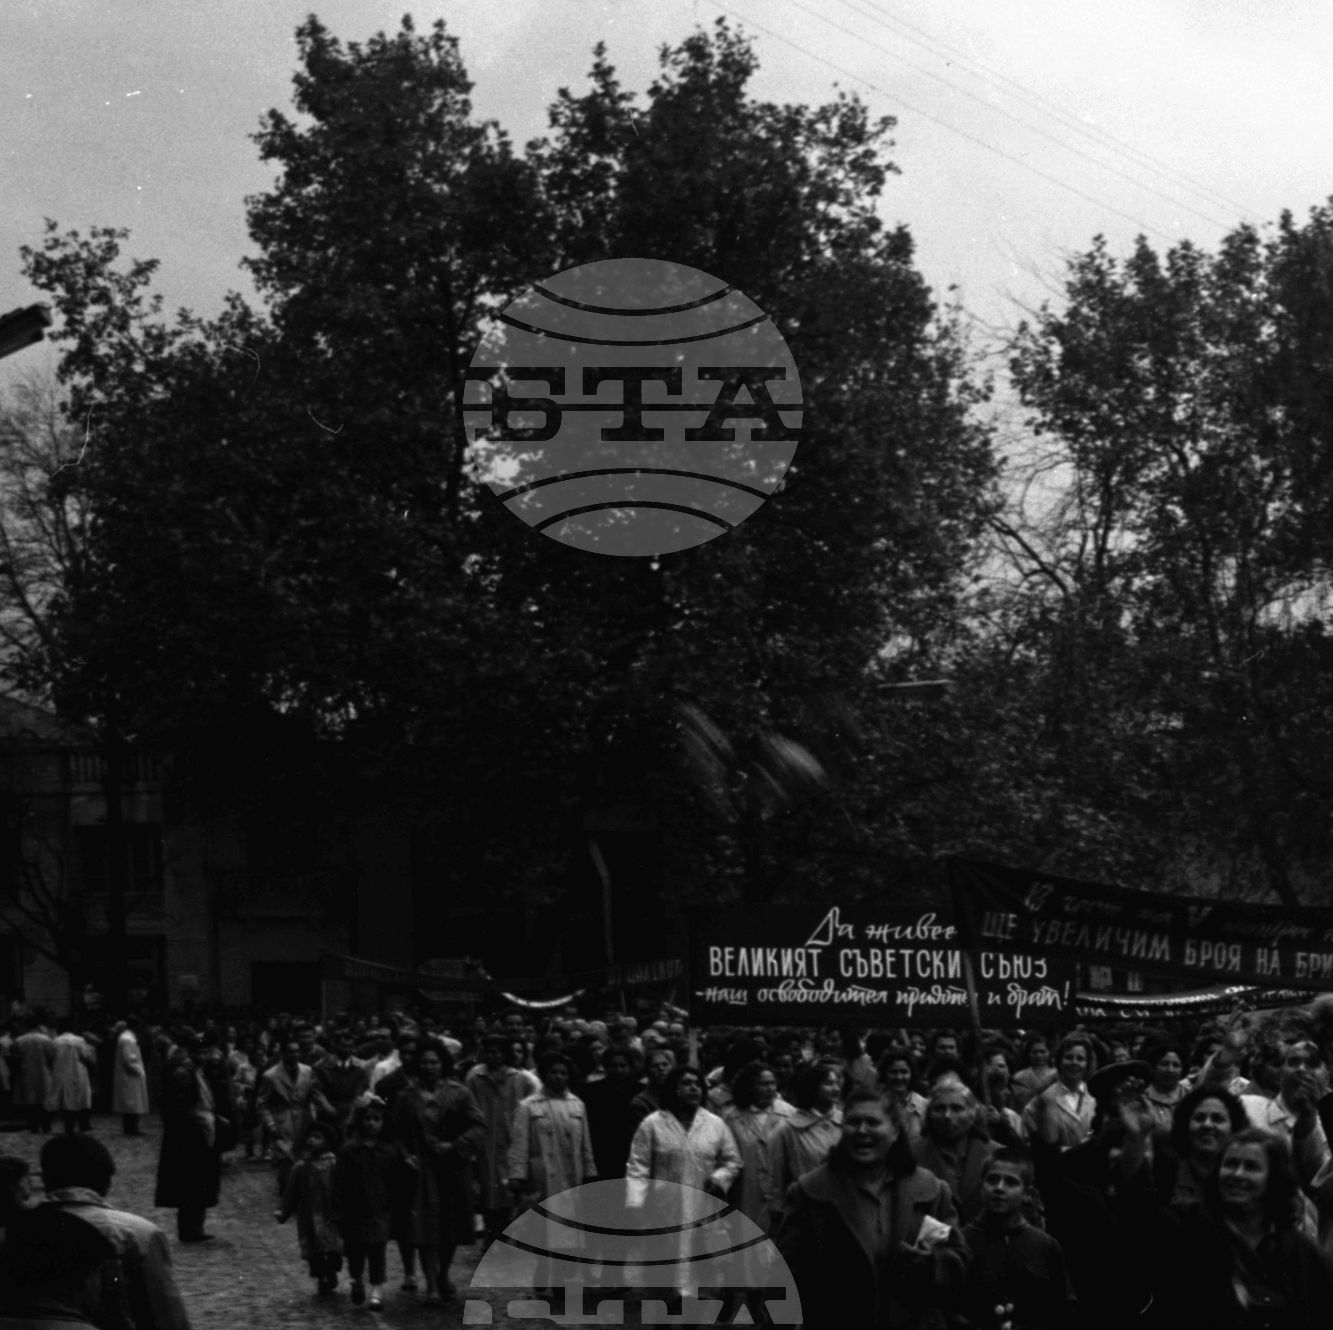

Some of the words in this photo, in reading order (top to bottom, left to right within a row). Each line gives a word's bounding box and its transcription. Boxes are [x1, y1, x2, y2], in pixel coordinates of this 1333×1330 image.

[804, 906, 857, 947] Да
[864, 912, 958, 944] живее
[981, 910, 1018, 941] ЩЕ
[1031, 918, 1171, 963] УВЕЛИЧИМ
[1184, 938, 1242, 973] БРОЯ
[1255, 946, 1281, 978] НА
[709, 946, 823, 978] ВЕЛИКИЯТ
[839, 949, 962, 980] СЪВЕТСКИ
[980, 952, 1048, 980] СЪЮЗ
[756, 977, 889, 1007] освободител
[986, 990, 1002, 1006] и
[1006, 979, 1071, 1020] брат!
